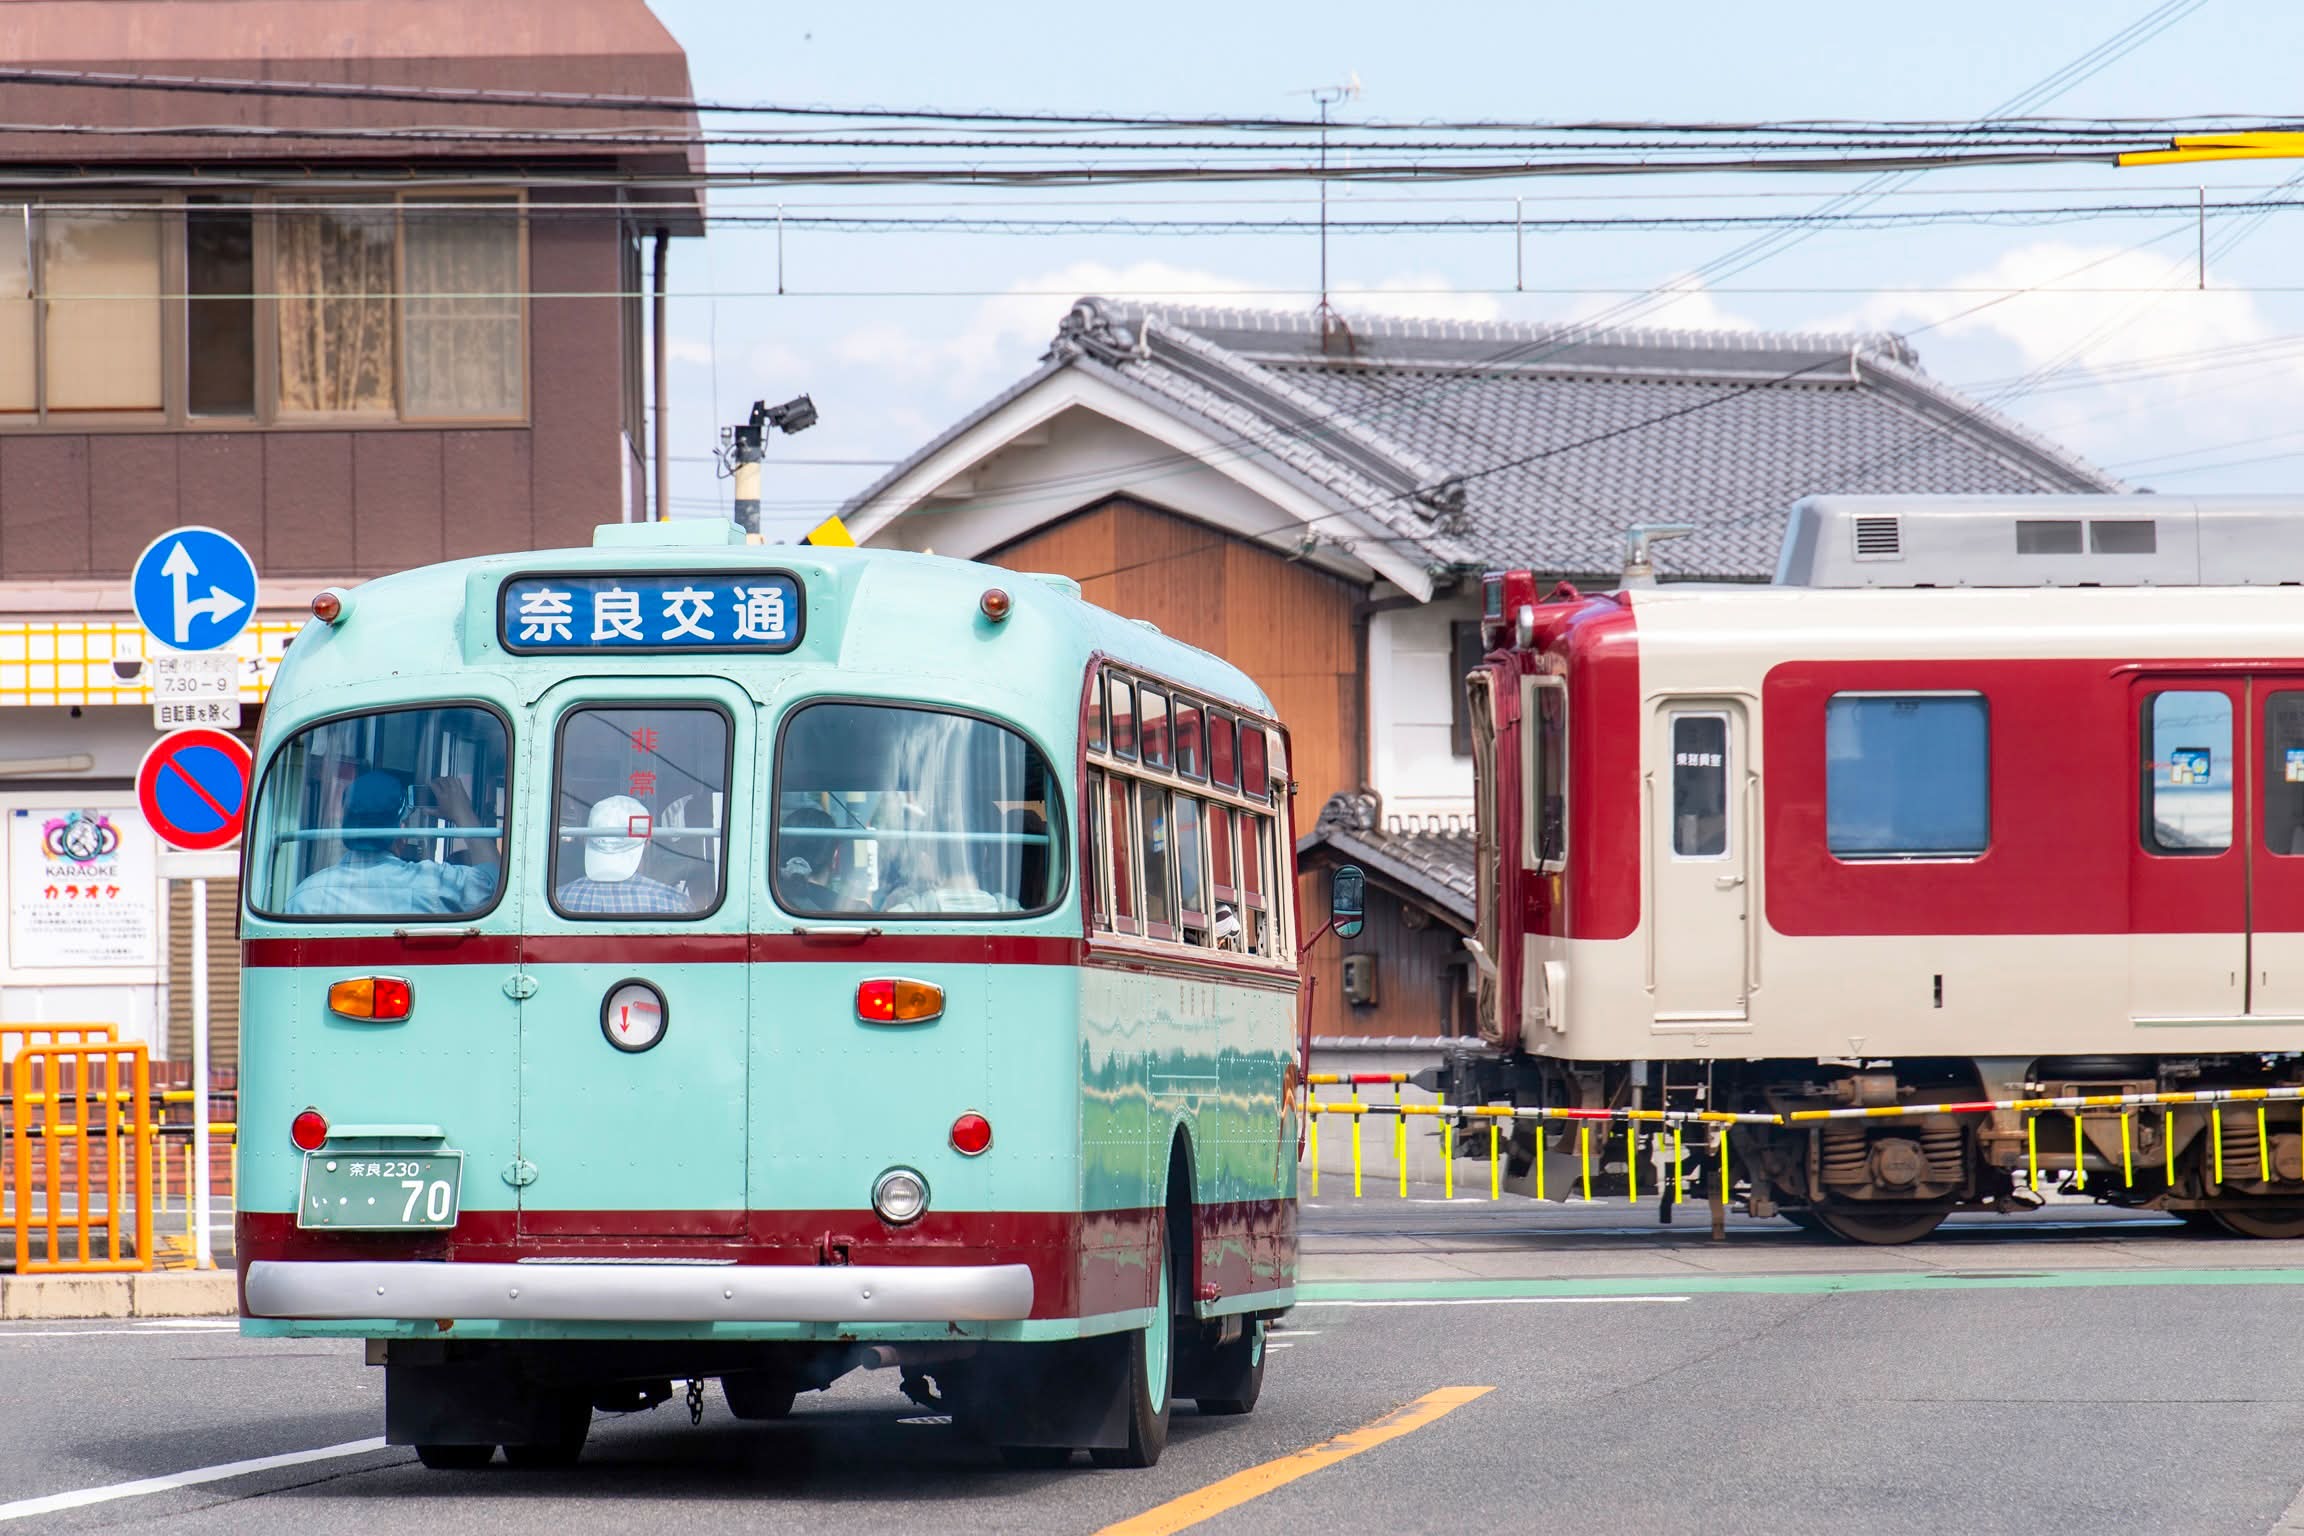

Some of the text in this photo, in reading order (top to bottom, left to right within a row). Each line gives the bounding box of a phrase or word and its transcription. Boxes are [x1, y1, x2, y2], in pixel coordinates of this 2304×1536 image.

[519, 586, 786, 642] 奈良交通
[161, 703, 231, 723] 自転車を除く
[628, 727, 660, 839] 非常口
[45, 865, 119, 877] KARAOKE
[44, 884, 121, 900] カラオケ
[349, 1162, 420, 1177] 奈良230
[401, 1180, 451, 1222] 70
